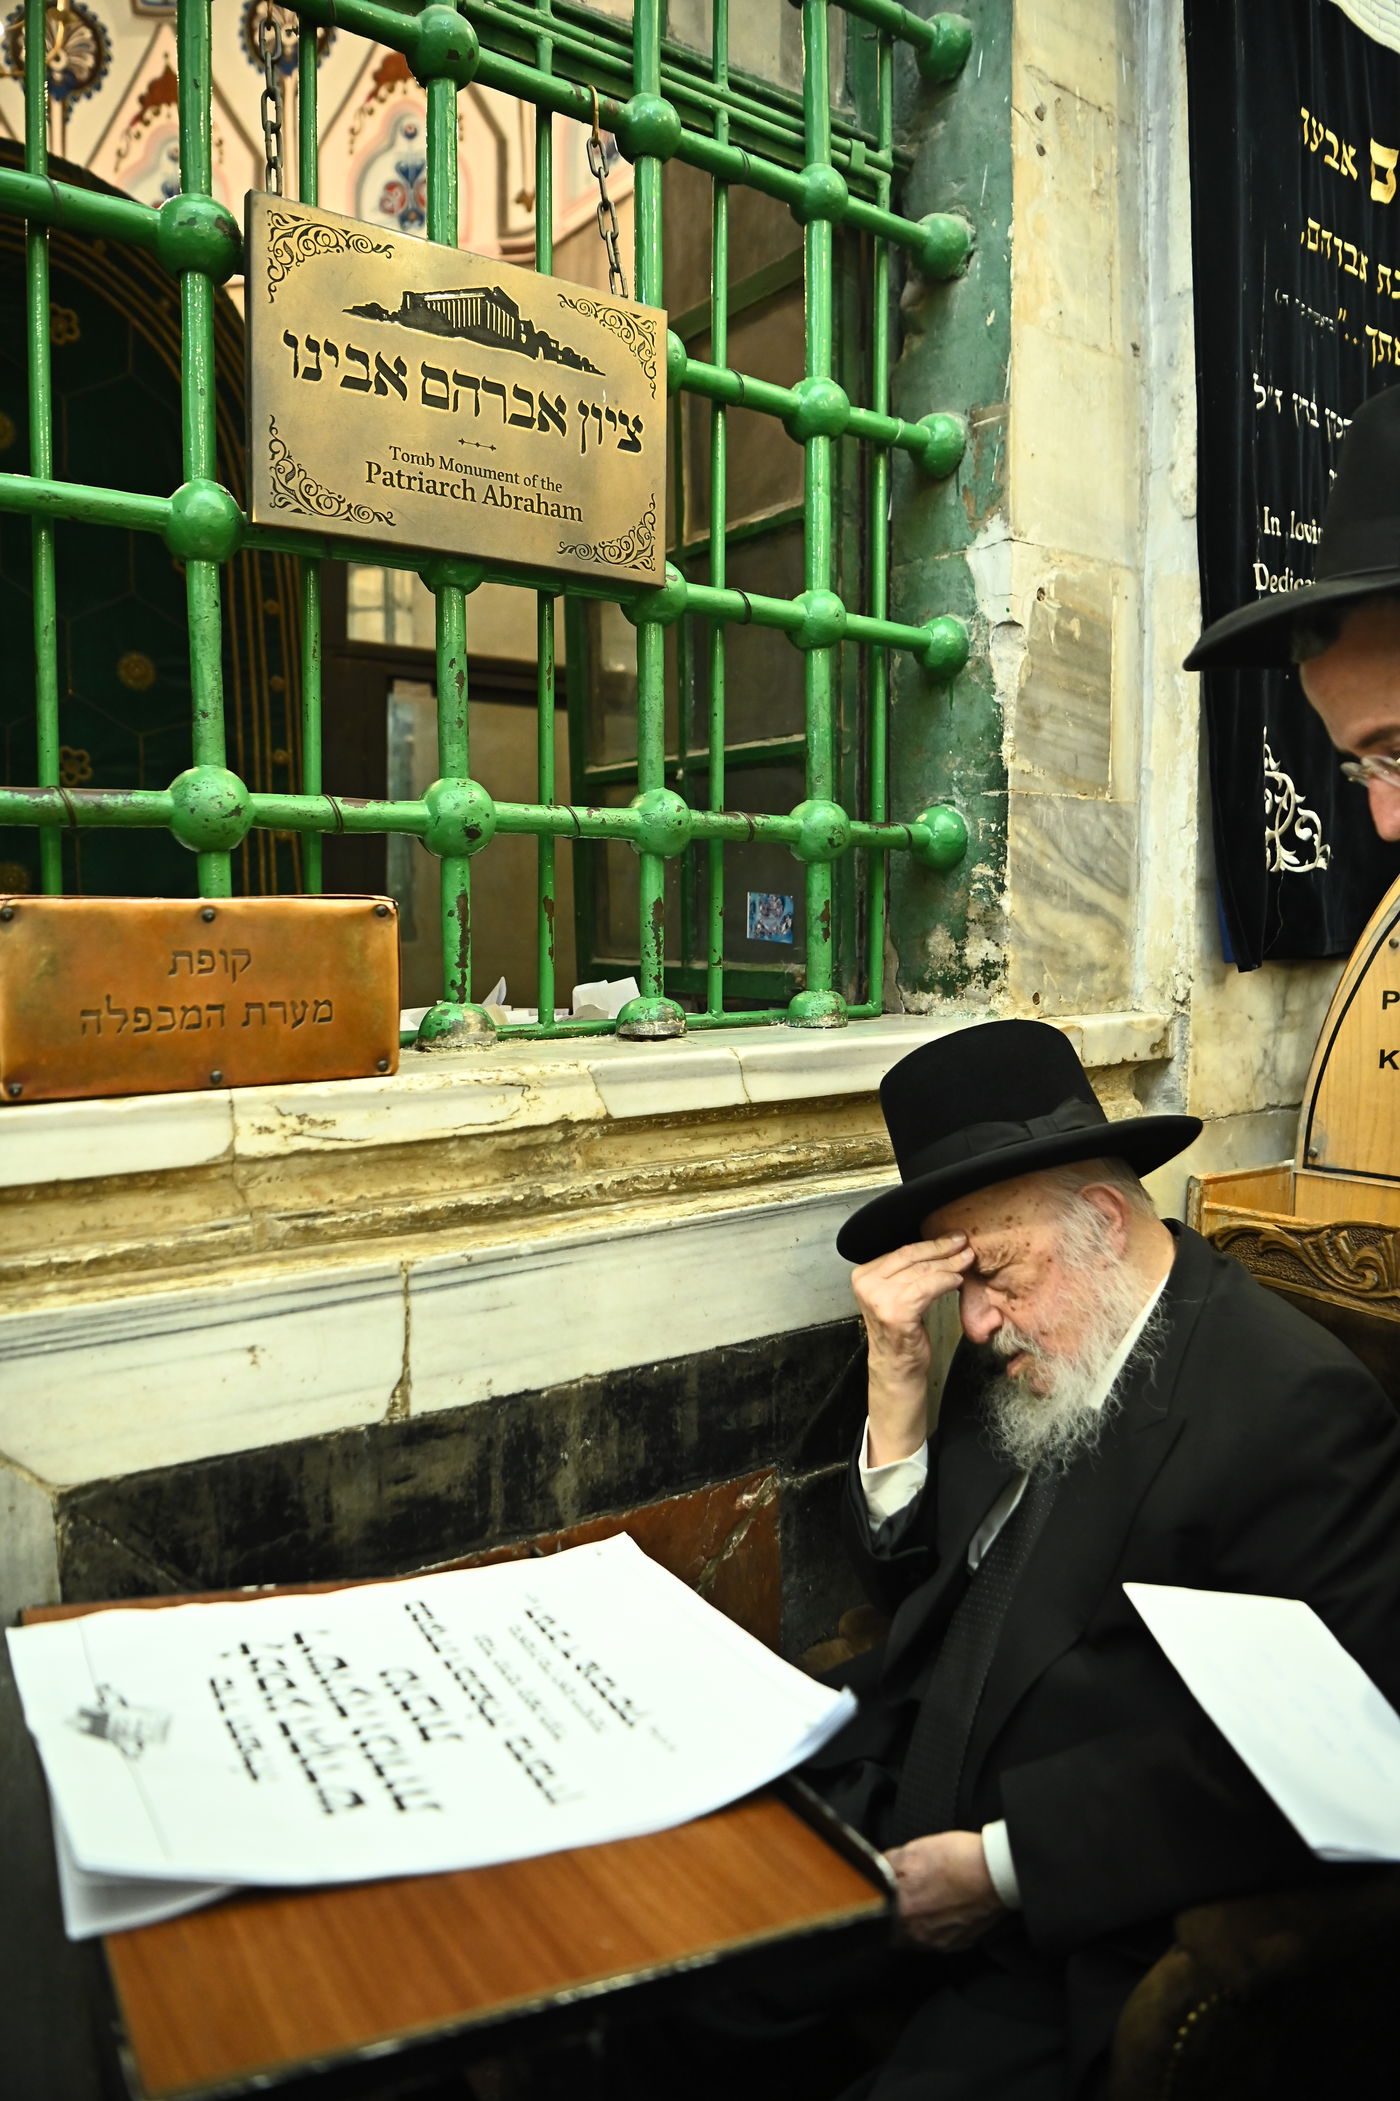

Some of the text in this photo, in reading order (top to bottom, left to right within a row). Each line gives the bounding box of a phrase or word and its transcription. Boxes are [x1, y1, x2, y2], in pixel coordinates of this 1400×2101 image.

[1300, 106, 1358, 181] אבינו
[282, 328, 644, 456] ציון אברהם אבינו
[365, 460, 584, 523] Patriarch Abraham
[388, 445, 563, 494] Tomb Monument of the
[1263, 505, 1282, 537] In
[168, 948, 252, 984] קופת
[79, 993, 334, 1036] מערת המכפלה
